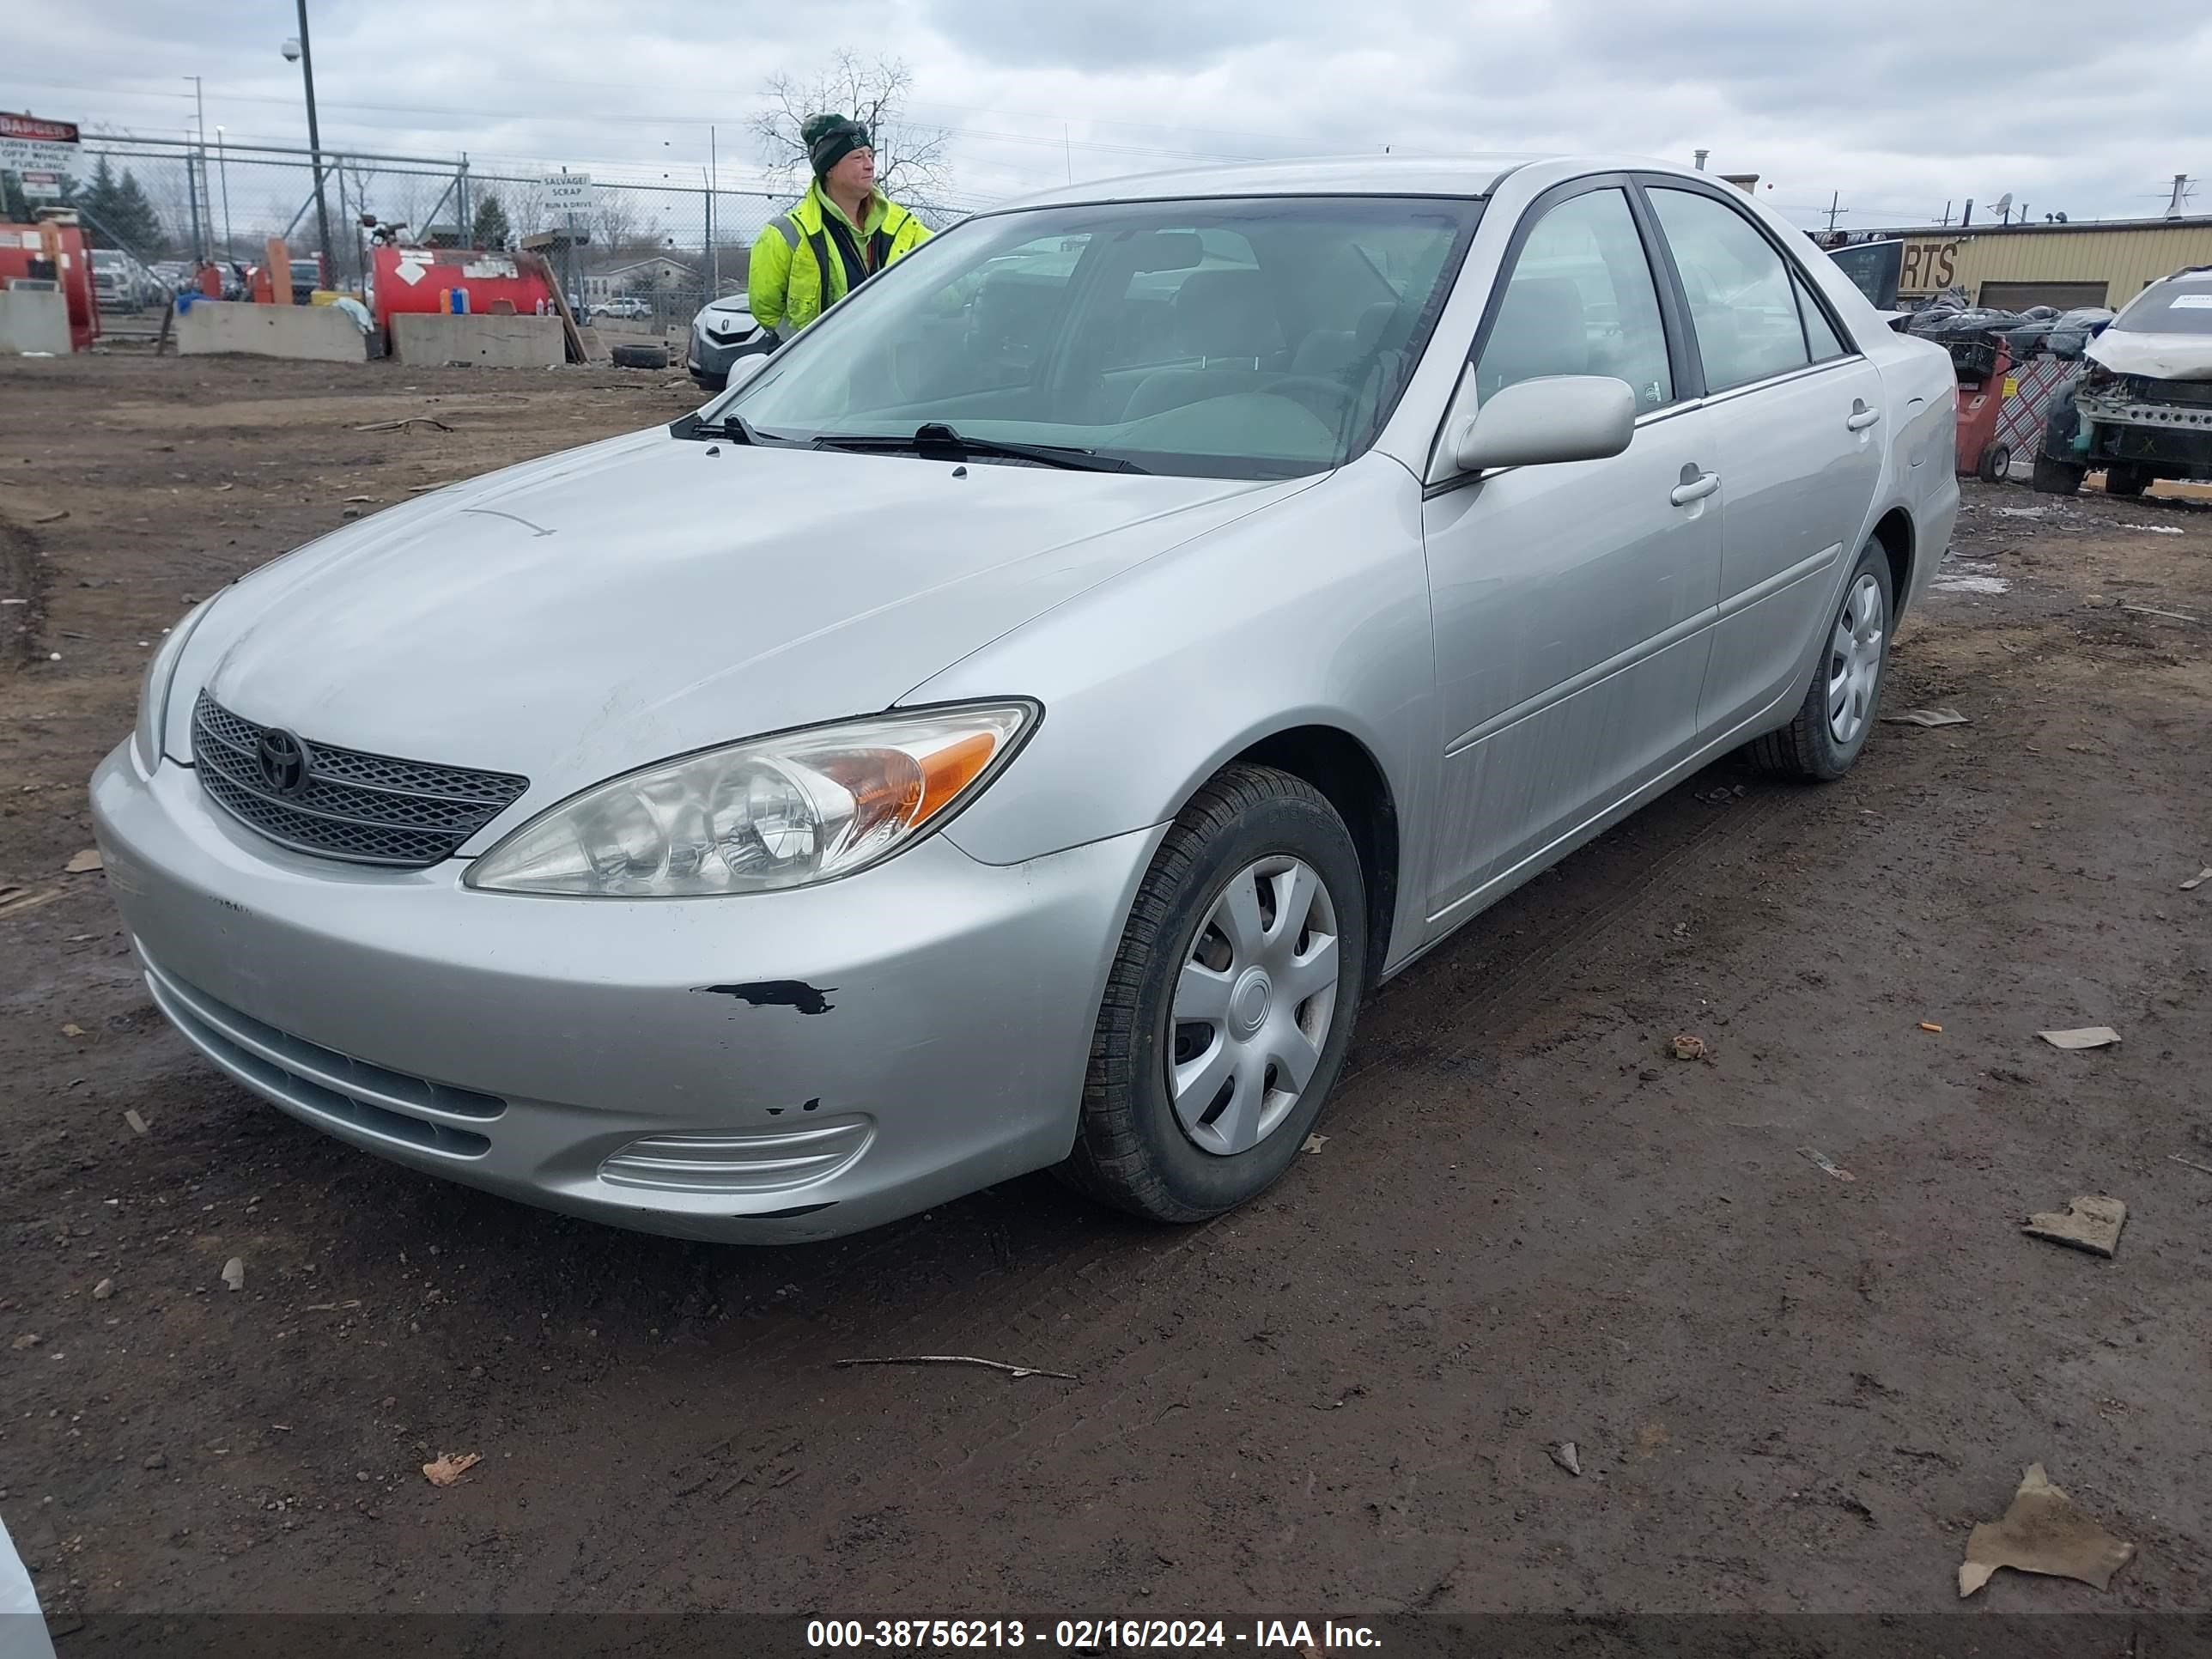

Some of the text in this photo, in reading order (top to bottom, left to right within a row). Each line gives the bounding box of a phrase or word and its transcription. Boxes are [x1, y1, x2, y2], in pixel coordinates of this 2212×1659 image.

[0, 118, 65, 137] DANGER
[552, 188, 582, 197] SCRAP
[1899, 243, 1958, 289] RTS
